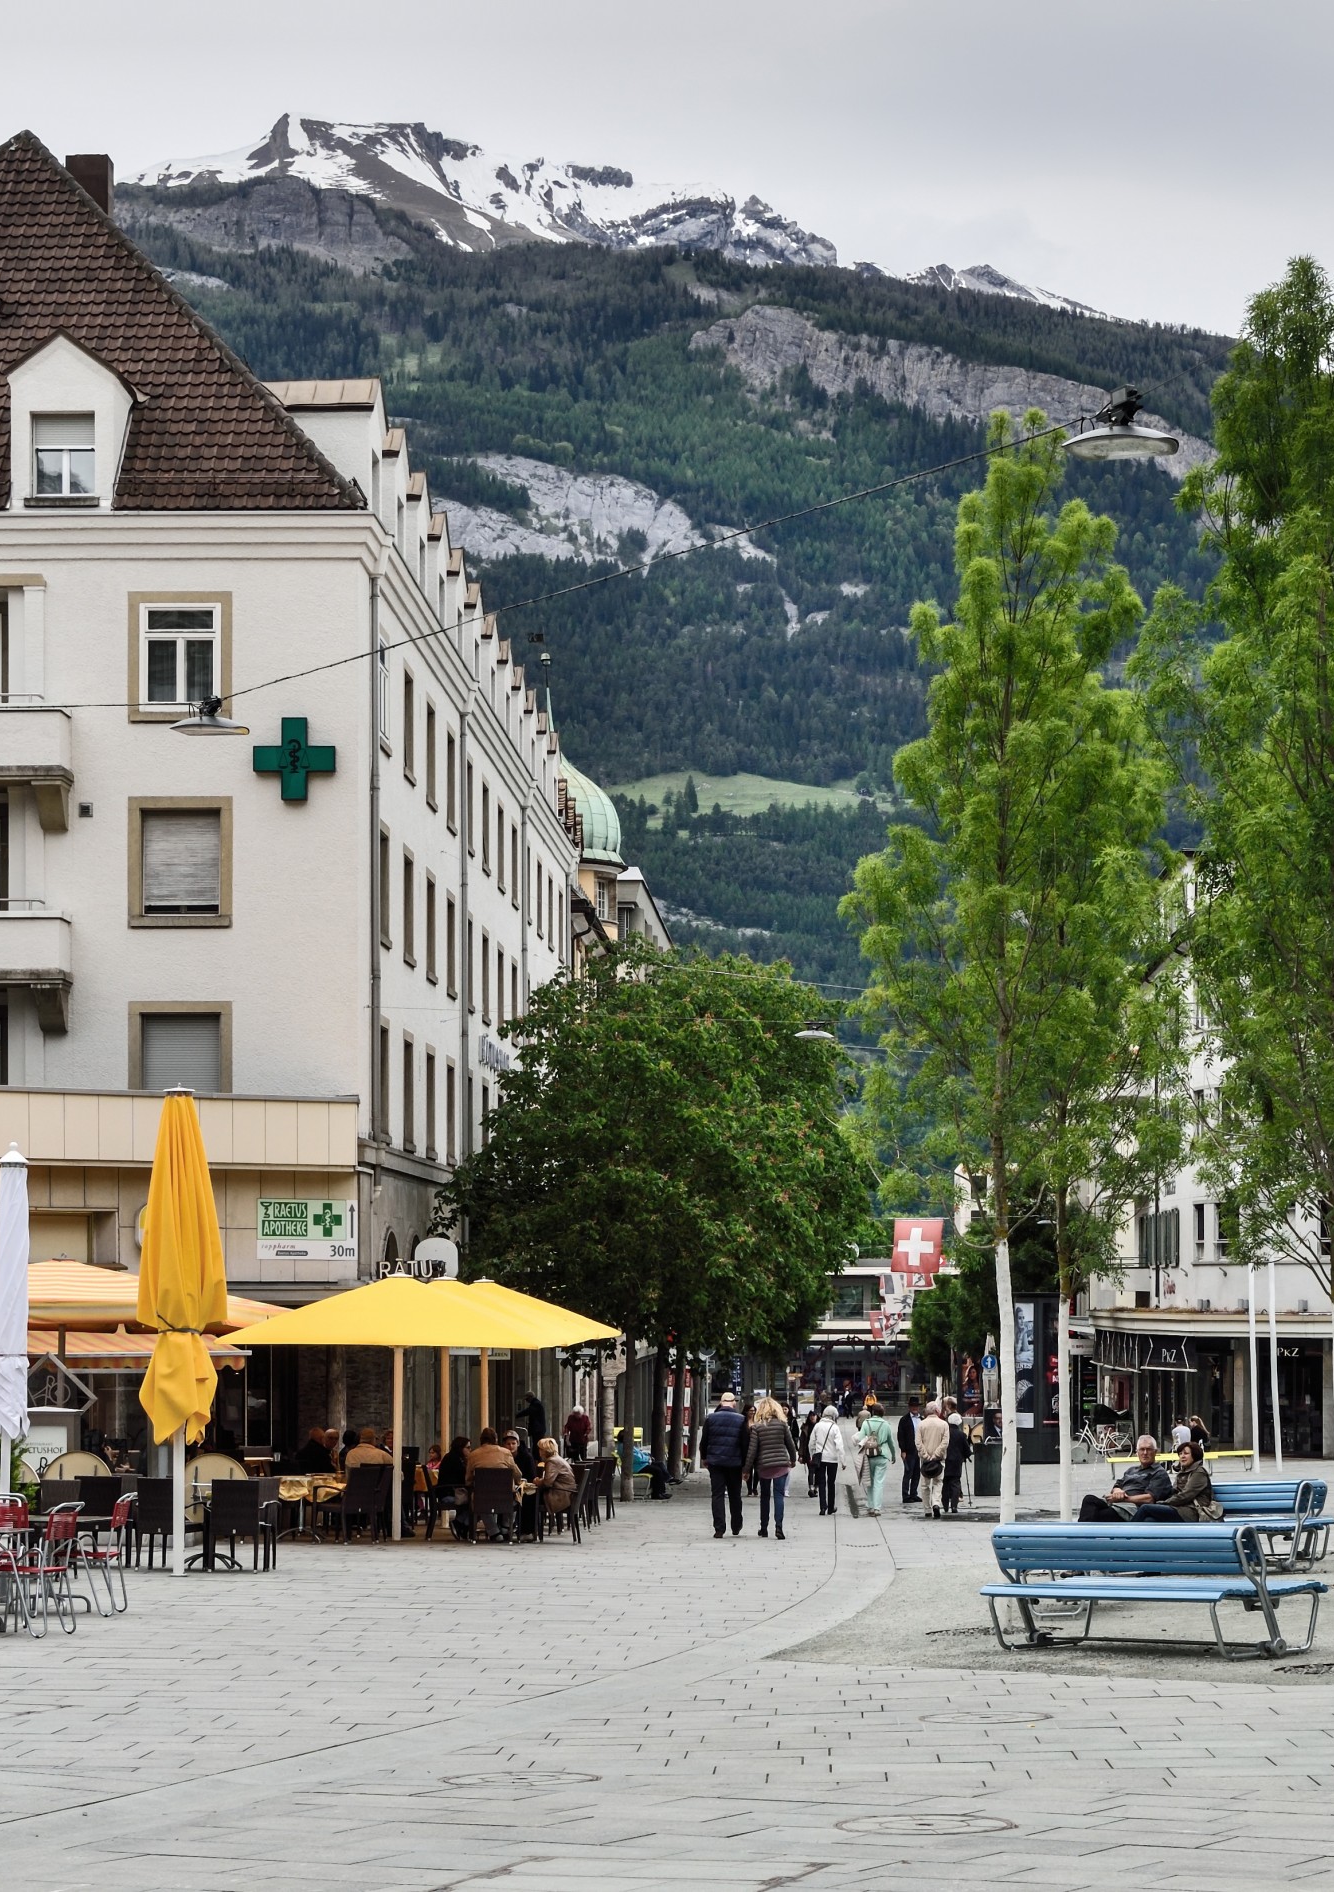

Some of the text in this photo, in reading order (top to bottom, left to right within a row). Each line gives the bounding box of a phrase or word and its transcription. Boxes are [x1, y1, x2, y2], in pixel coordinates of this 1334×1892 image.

[274, 1203, 307, 1218] RAETUS
[263, 1221, 307, 1235] APOTHEKE
[330, 1245, 355, 1257] 30m
